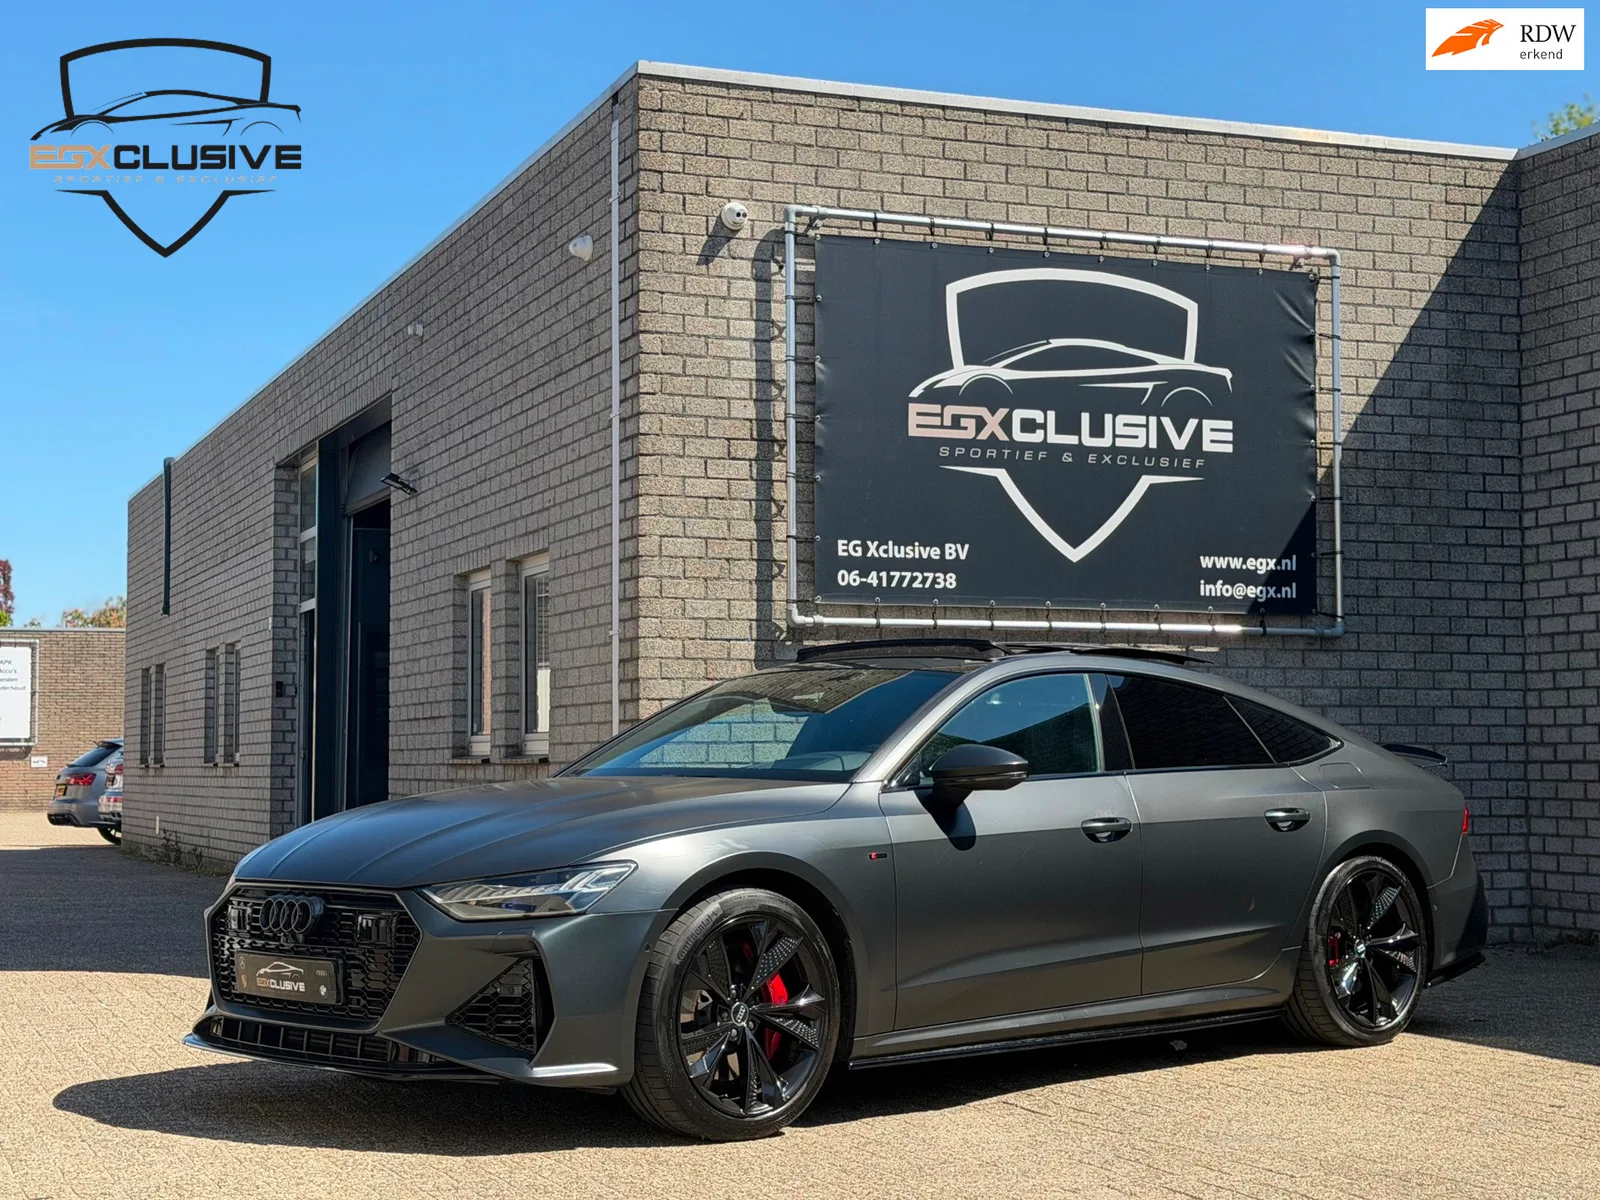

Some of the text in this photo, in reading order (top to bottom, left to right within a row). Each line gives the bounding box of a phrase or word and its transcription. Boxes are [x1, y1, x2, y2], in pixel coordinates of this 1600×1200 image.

[908, 402, 1233, 453] EGXCLUSIVE
[939, 446, 1206, 469] SPORTIEF & EXCLUSIEF
[837, 539, 970, 560] EG Xclusive BV
[1199, 554, 1297, 575] www.egx.nl
[837, 569, 957, 589] 06-41772738
[1199, 579, 1297, 602] info@egx.nl
